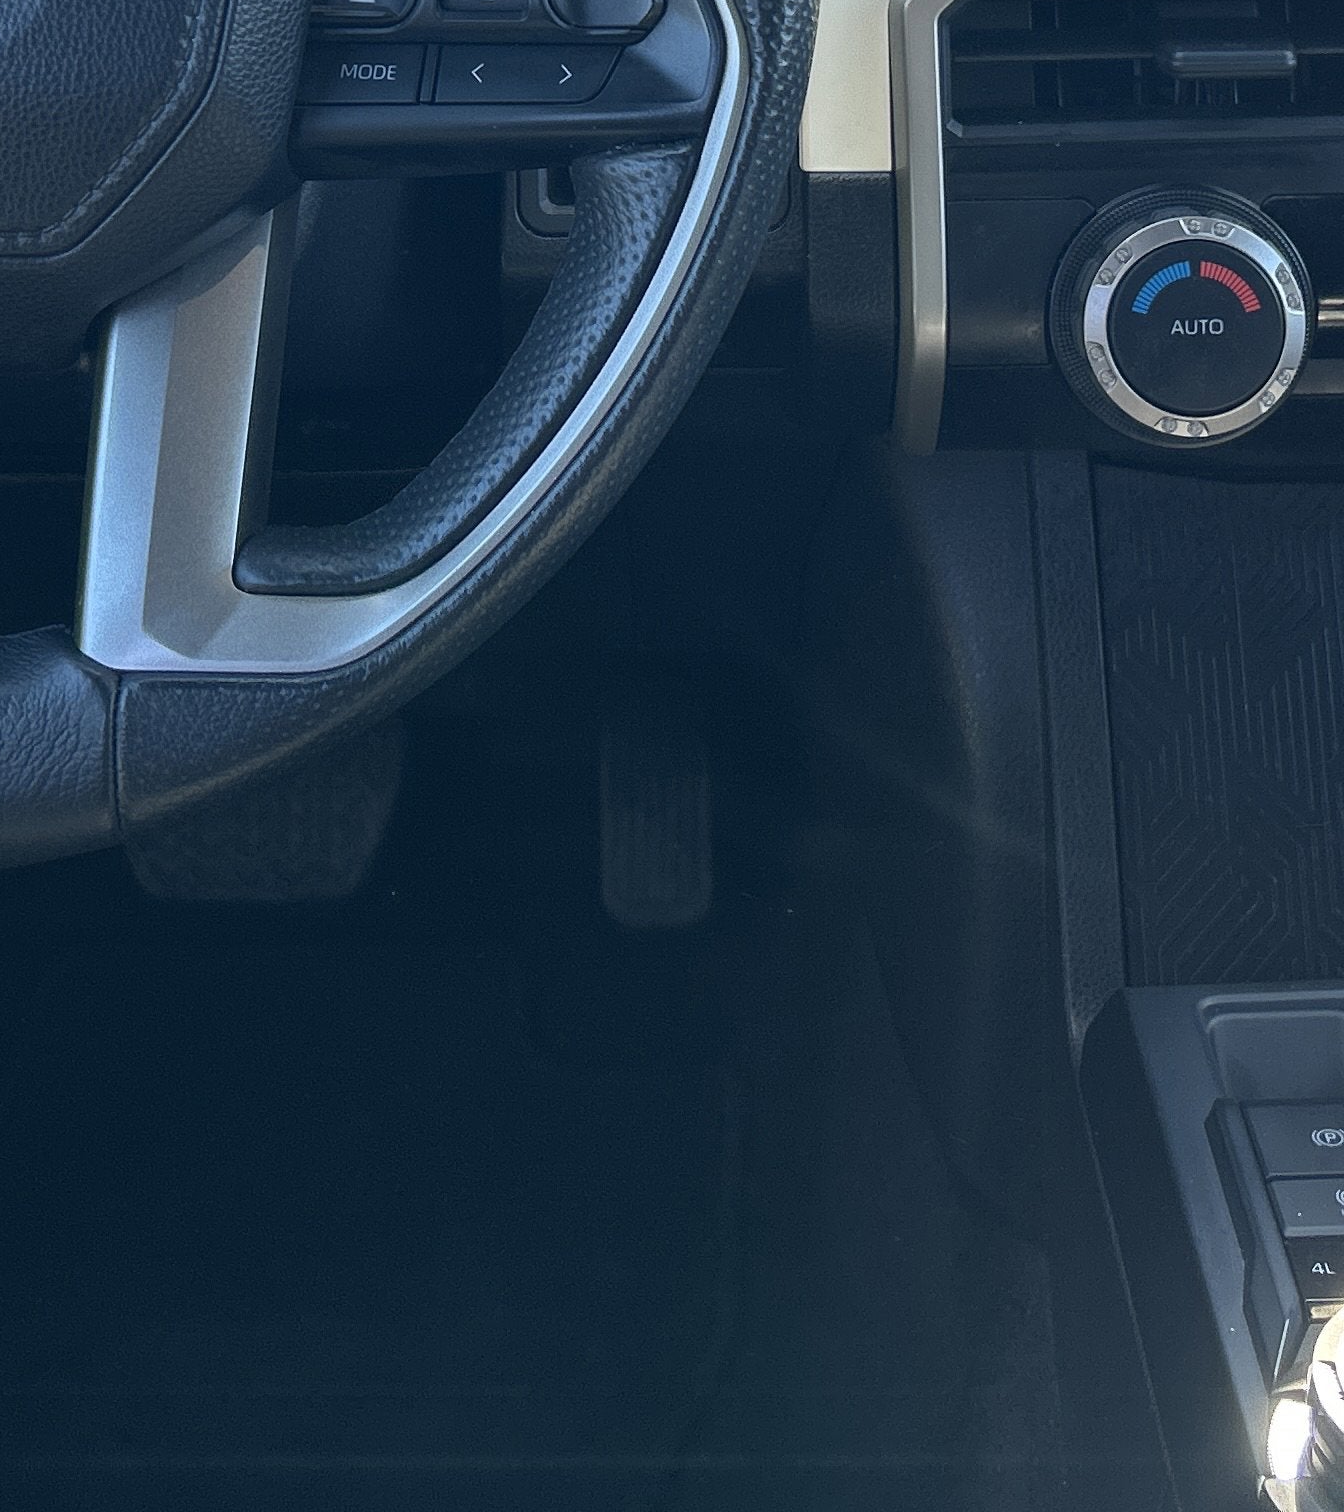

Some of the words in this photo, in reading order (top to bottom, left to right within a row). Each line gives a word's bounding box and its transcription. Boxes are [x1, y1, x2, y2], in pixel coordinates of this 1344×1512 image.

[340, 64, 397, 81] MODE
[1170, 318, 1224, 336] AUTO
[1311, 1262, 1336, 1275] 4L
